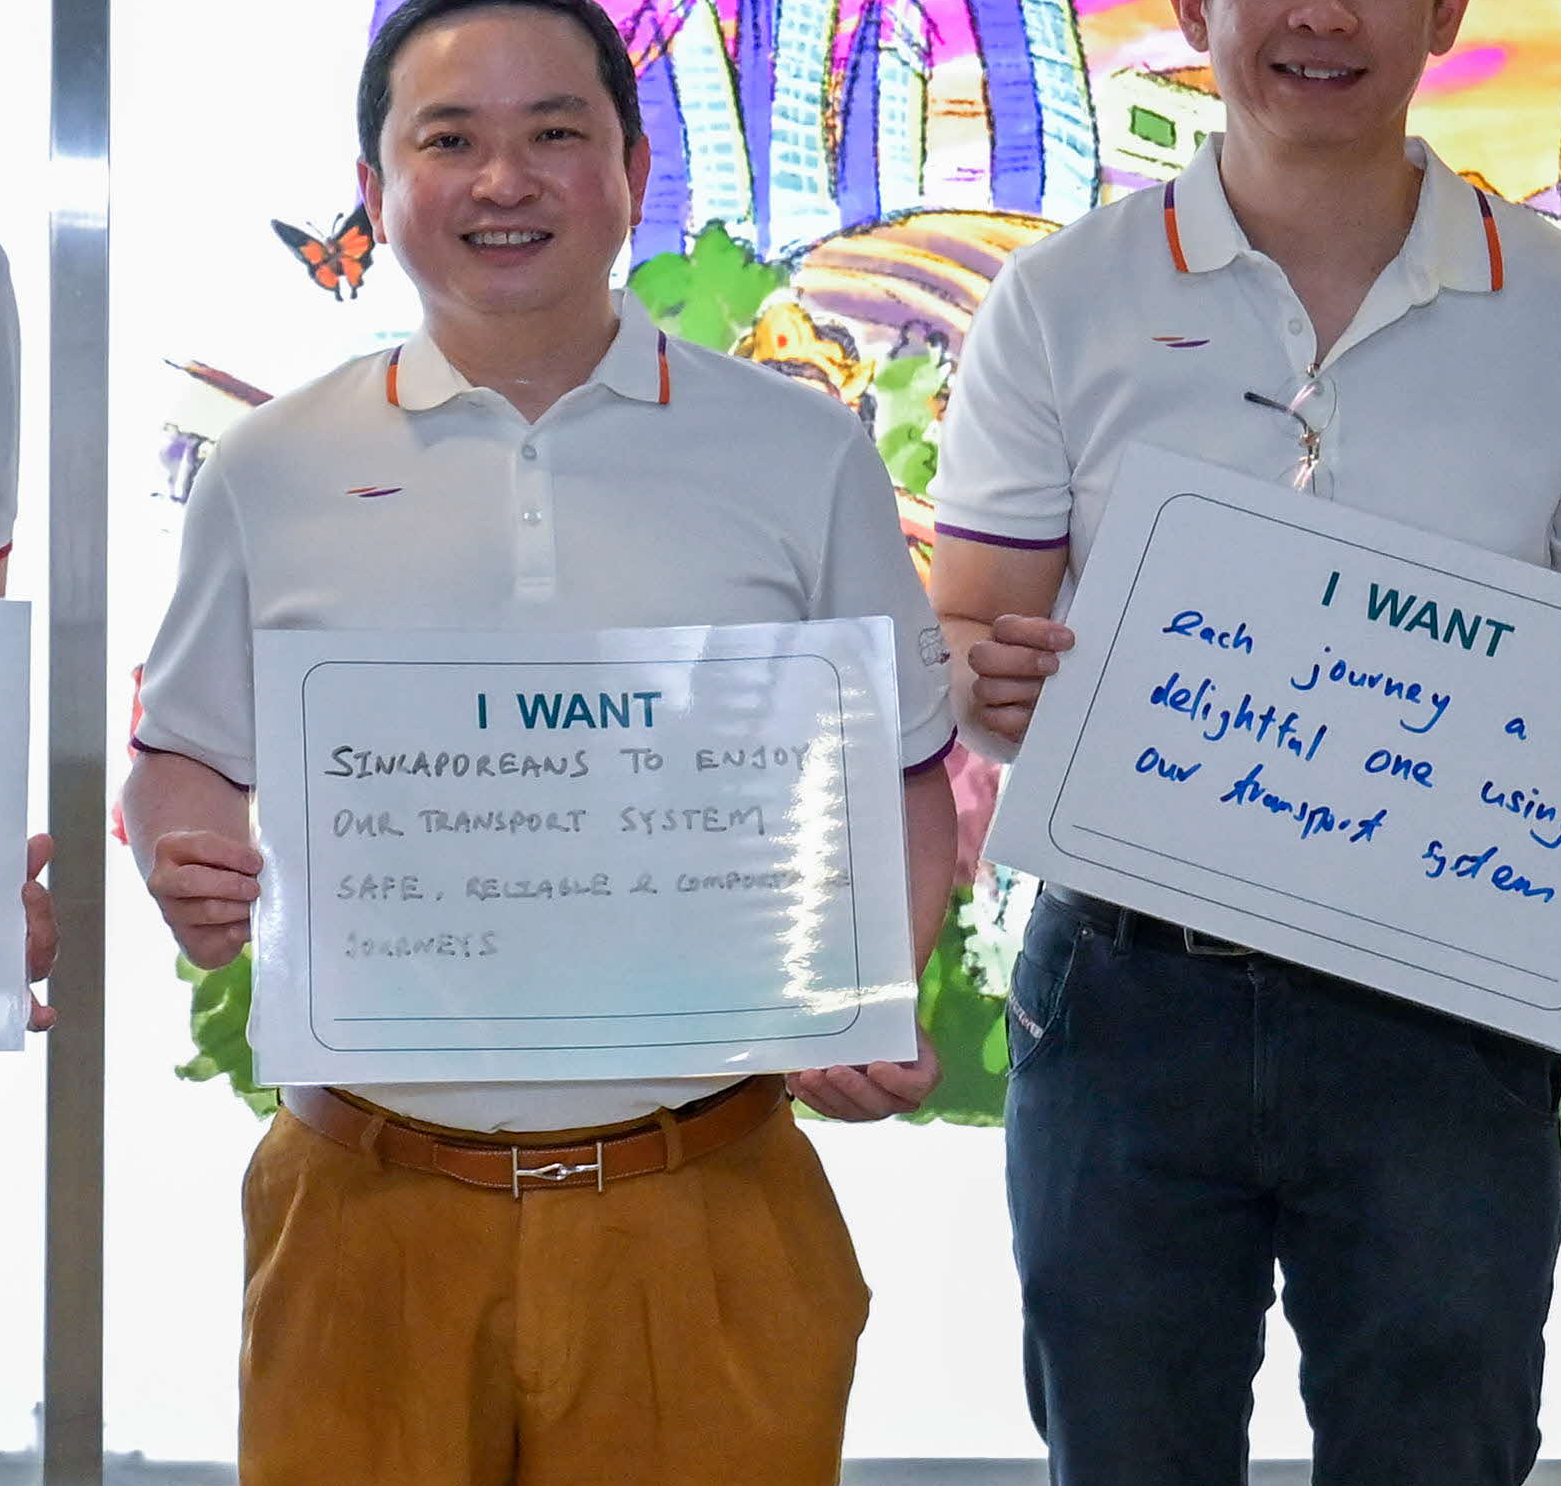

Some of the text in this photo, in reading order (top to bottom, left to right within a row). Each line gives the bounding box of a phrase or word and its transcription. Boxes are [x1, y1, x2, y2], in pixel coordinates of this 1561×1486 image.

[1320, 571, 1515, 658] I WANT
[478, 691, 663, 730] I WANT
[1290, 645, 1451, 734] journey
[1504, 716, 1528, 740] a
[619, 746, 665, 774] TO
[1135, 746, 1202, 782] our
[1364, 748, 1438, 789] one
[332, 805, 765, 837] OUR TRANSPORT SYSTEM
